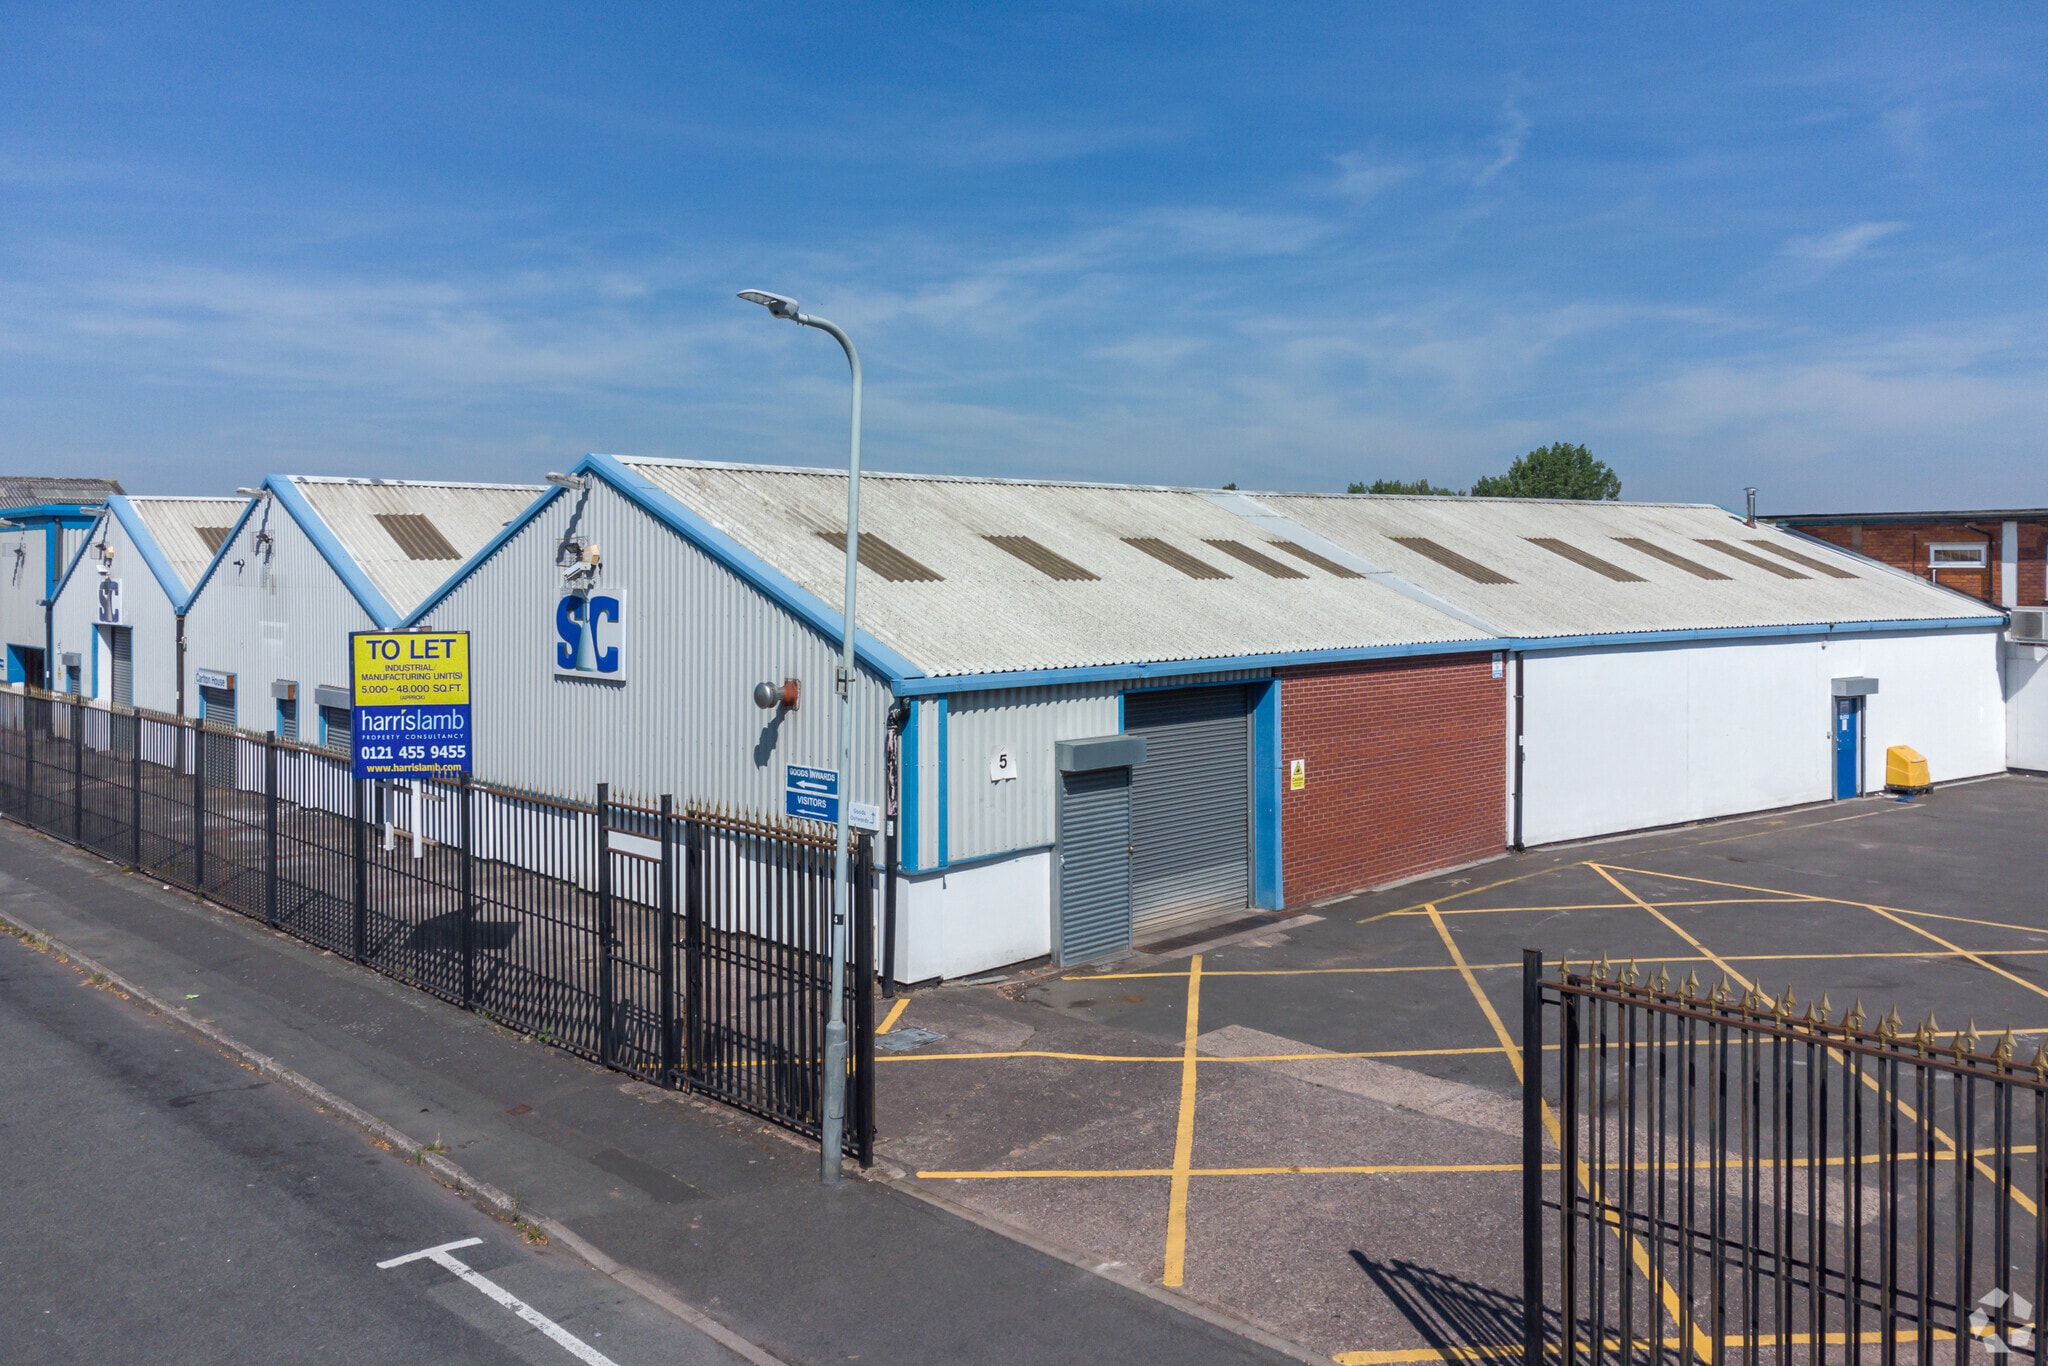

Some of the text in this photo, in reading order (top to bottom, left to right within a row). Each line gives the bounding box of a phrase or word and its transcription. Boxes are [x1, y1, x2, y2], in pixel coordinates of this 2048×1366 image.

[366, 639, 457, 660] TO LET
[361, 672, 463, 681] MANUFACTURING UNIT(S)
[361, 685, 388, 694] 5,000
[396, 684, 430, 693] 48,000
[362, 708, 465, 731] harrislamb
[361, 744, 466, 760] 0121 455 9455
[366, 763, 462, 773] www.harrislamb.com
[999, 753, 1008, 769] 5
[789, 767, 836, 782] GOODS INWARDS
[797, 795, 827, 808] VISITORS
